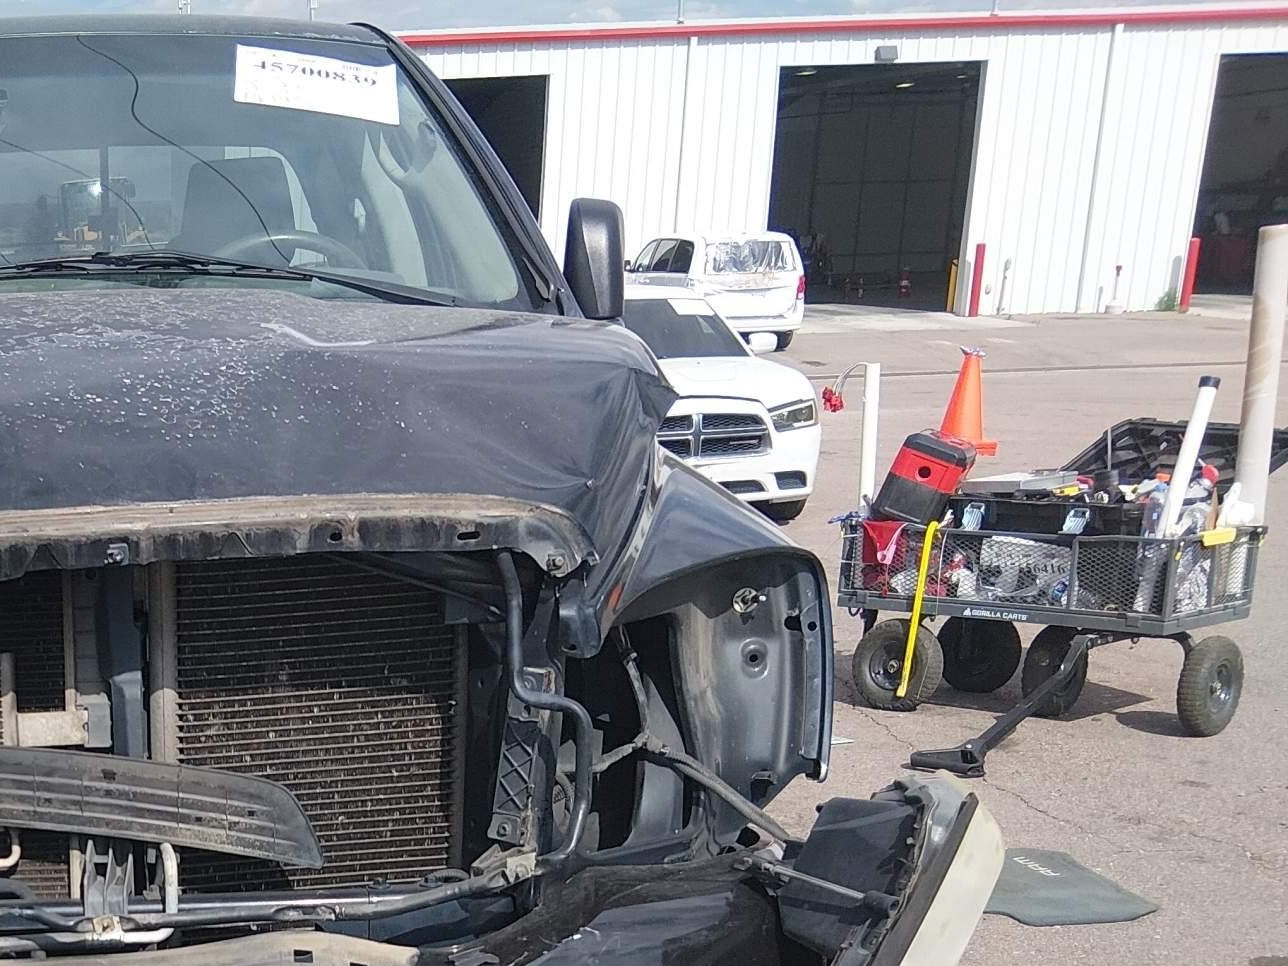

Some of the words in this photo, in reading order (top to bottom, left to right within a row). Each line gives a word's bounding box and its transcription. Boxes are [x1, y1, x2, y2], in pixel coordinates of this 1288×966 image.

[253, 60, 377, 87] 45700839
[972, 609, 1001, 618] GORILLA
[1002, 612, 1027, 620] CARTS
